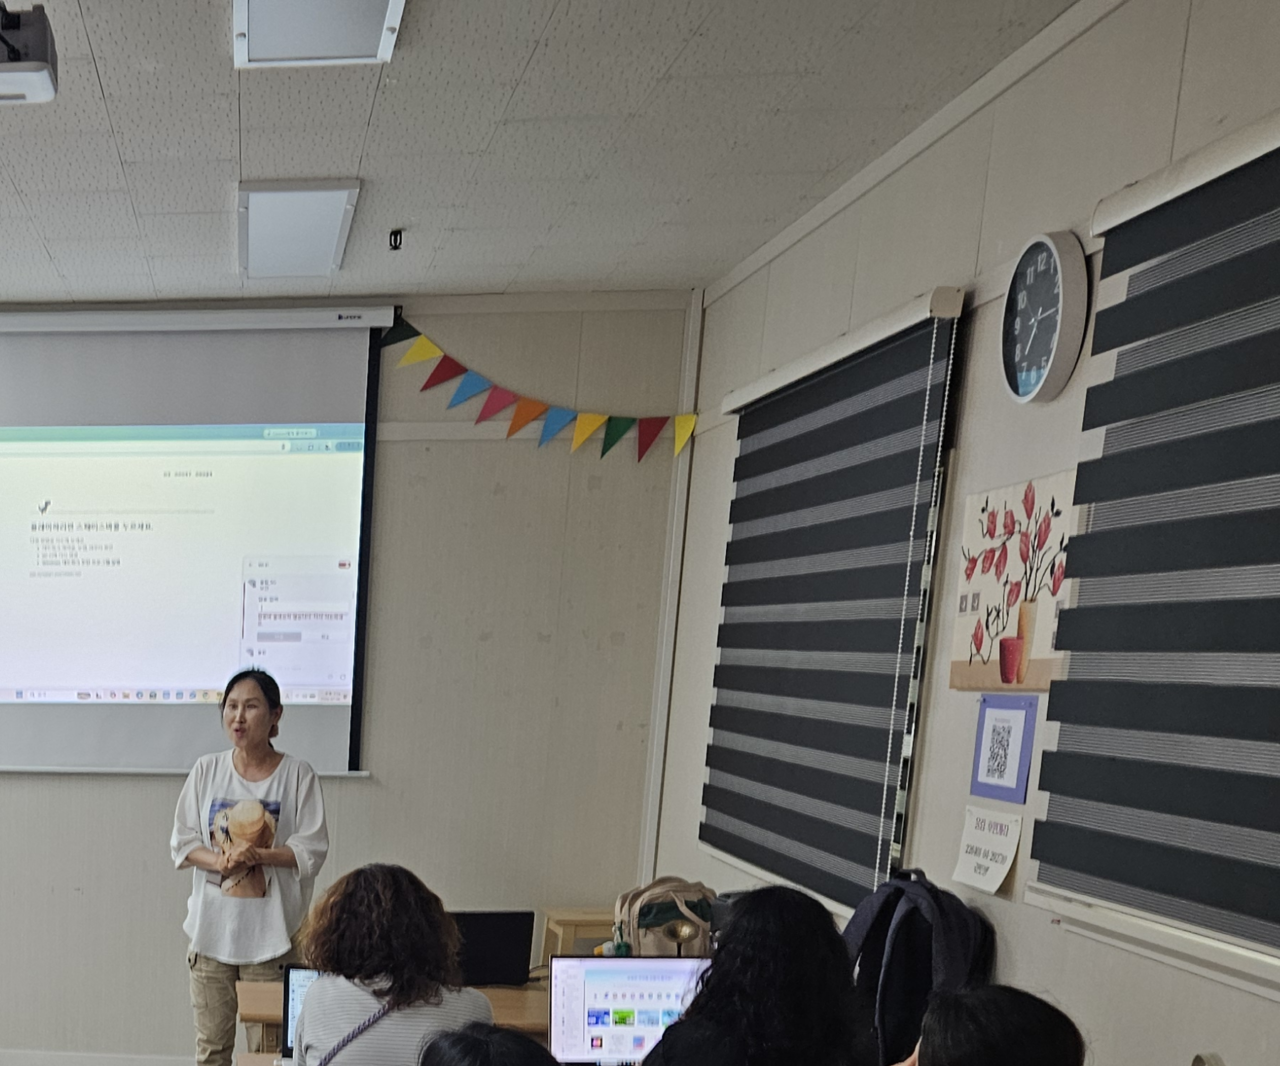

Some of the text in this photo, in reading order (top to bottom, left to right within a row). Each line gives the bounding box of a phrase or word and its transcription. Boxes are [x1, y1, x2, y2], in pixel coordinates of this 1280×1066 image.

[1037, 252, 1047, 272] 12
[1026, 267, 1035, 285] 11
[1018, 290, 1027, 310] 10
[1014, 317, 1021, 335] 9
[1015, 344, 1021, 363] 8
[1021, 362, 1027, 380] 7
